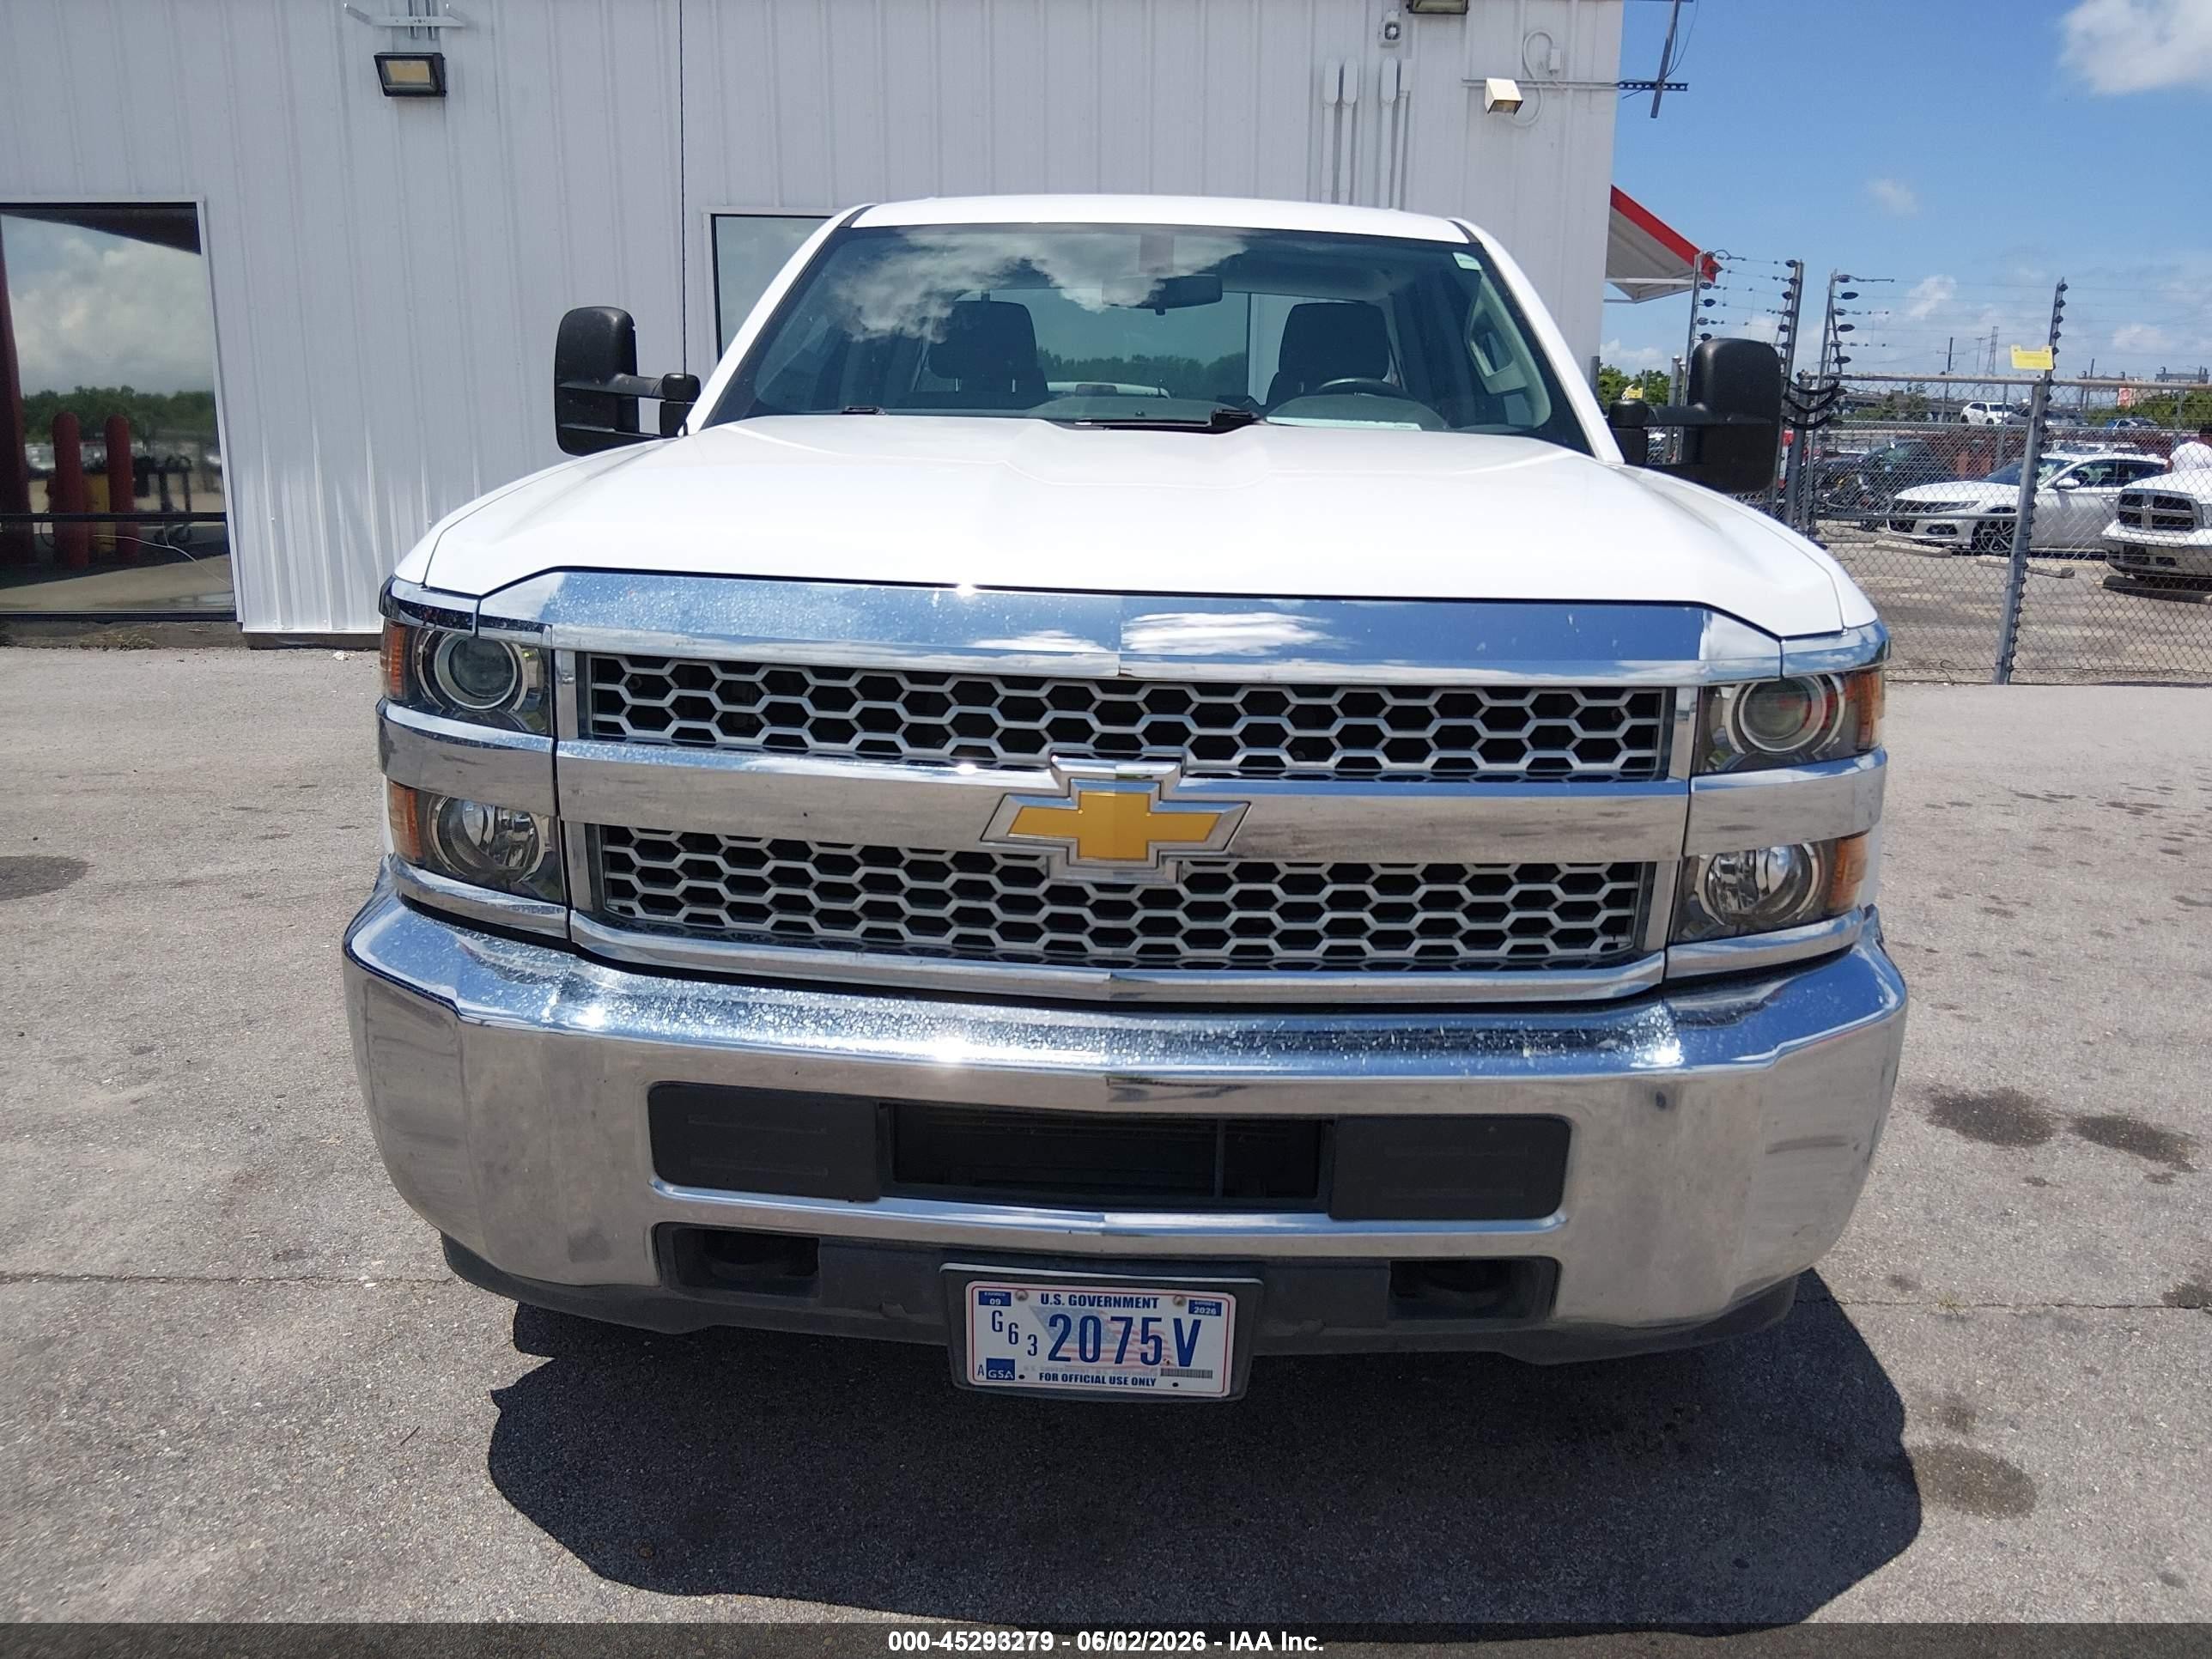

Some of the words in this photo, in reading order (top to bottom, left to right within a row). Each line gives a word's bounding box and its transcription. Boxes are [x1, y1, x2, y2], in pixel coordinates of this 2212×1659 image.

[1041, 1293, 1065, 1306] U.S.
[1068, 1294, 1158, 1310] GOVERNMENT
[1048, 1313, 1201, 1367] 2075V
[988, 1369, 1015, 1380] GSA
[1039, 1371, 1059, 1382] FOR
[1060, 1373, 1106, 1384] OFFICIAL
[1109, 1375, 1128, 1386] USE
[1131, 1376, 1157, 1388] ONLY
